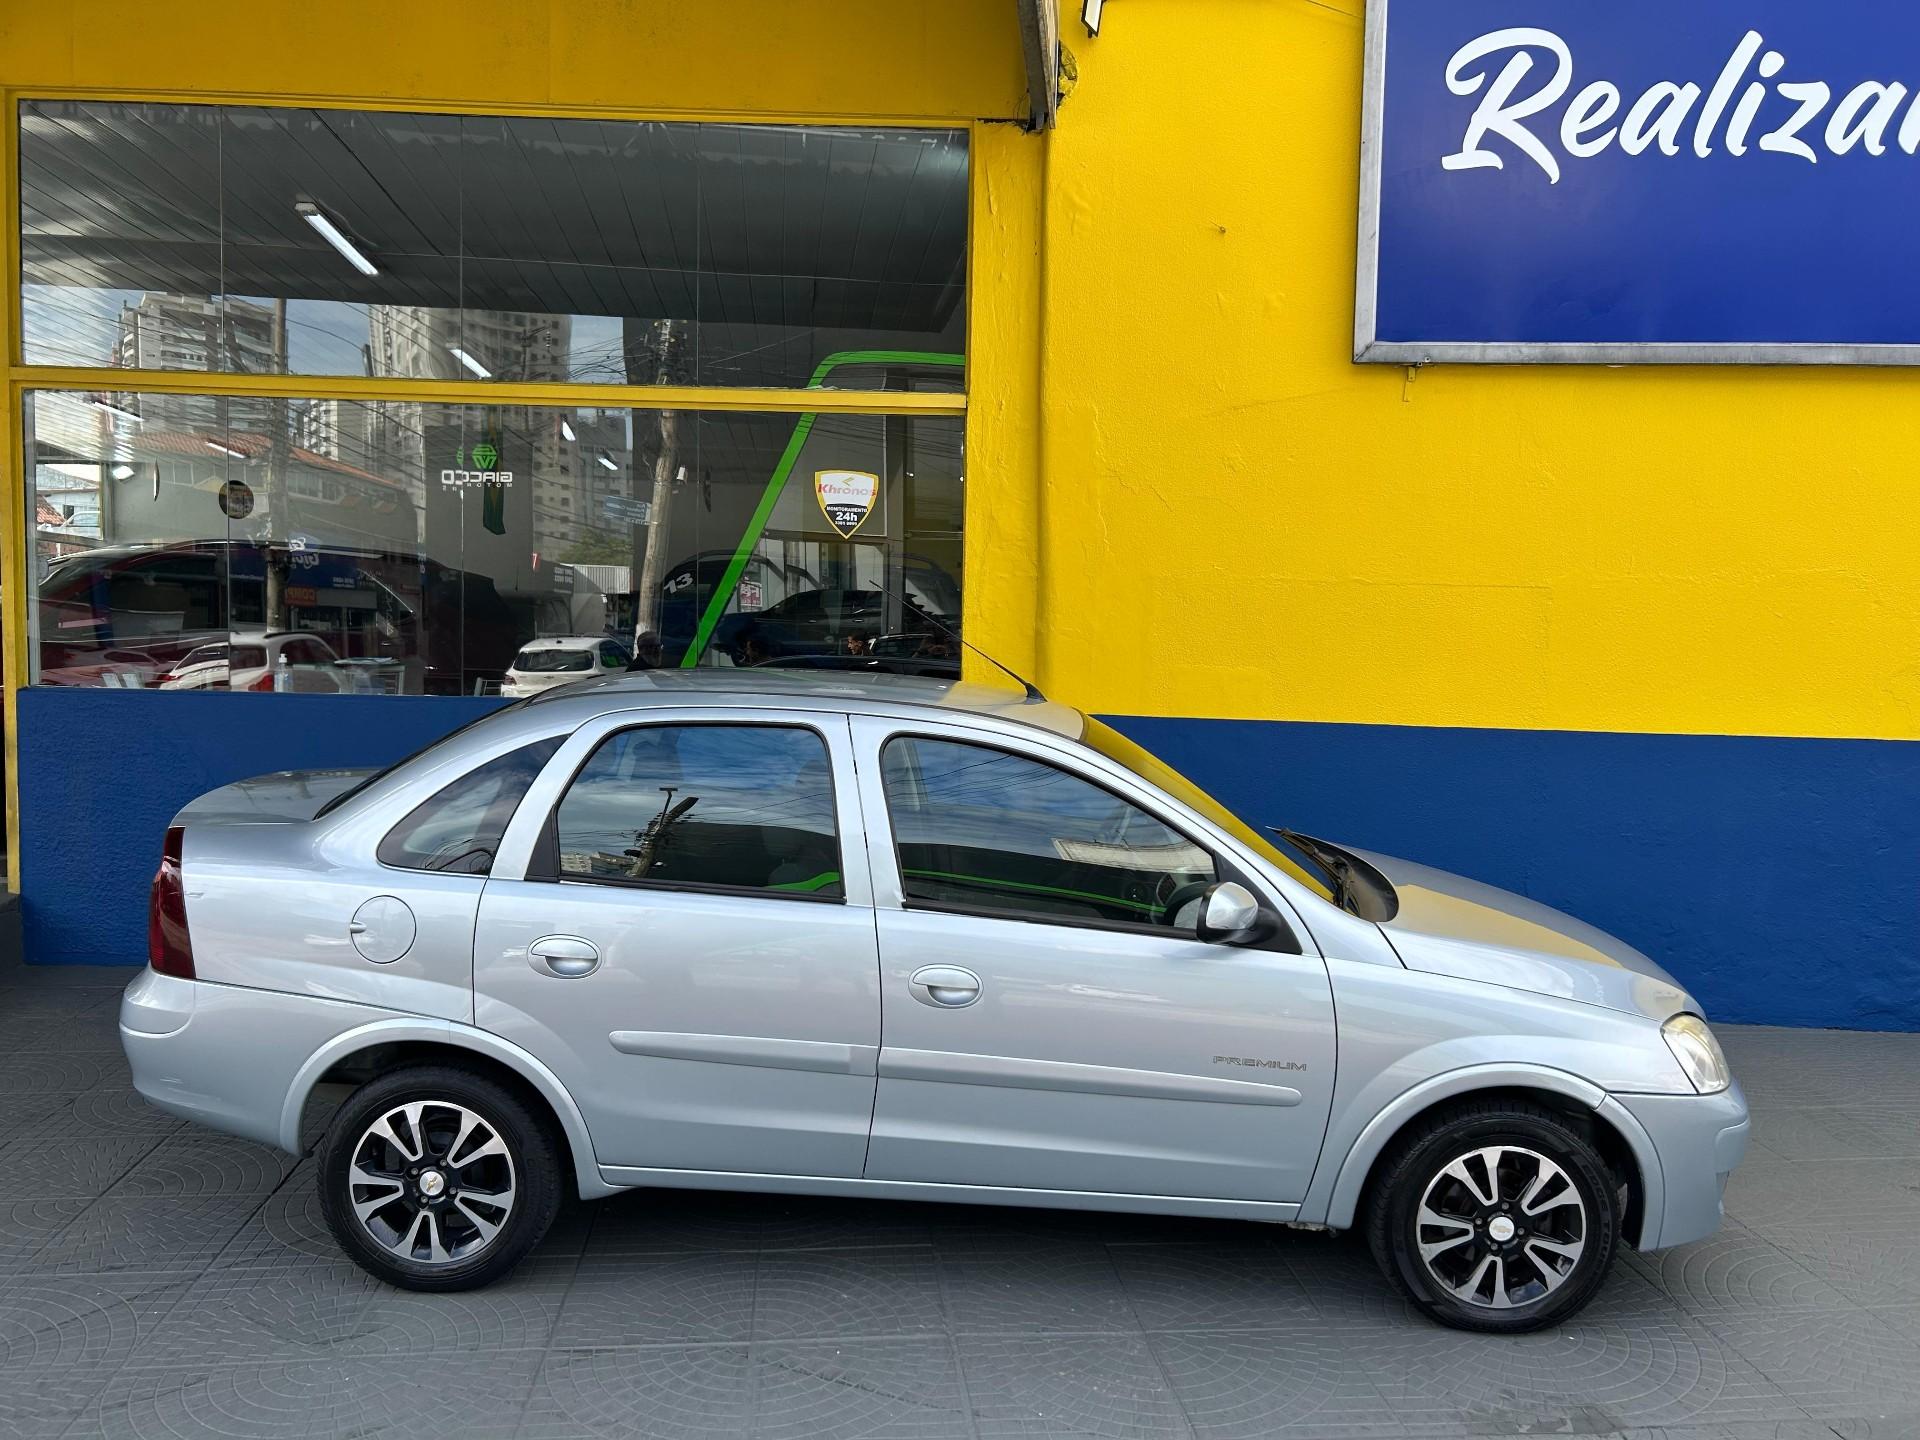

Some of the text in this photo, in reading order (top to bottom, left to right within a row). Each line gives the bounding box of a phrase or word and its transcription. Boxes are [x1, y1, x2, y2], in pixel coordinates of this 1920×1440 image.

[818, 484, 877, 497] Khronos
[835, 511, 858, 522] 24h
[1212, 1055, 1308, 1072] PREMIUM
